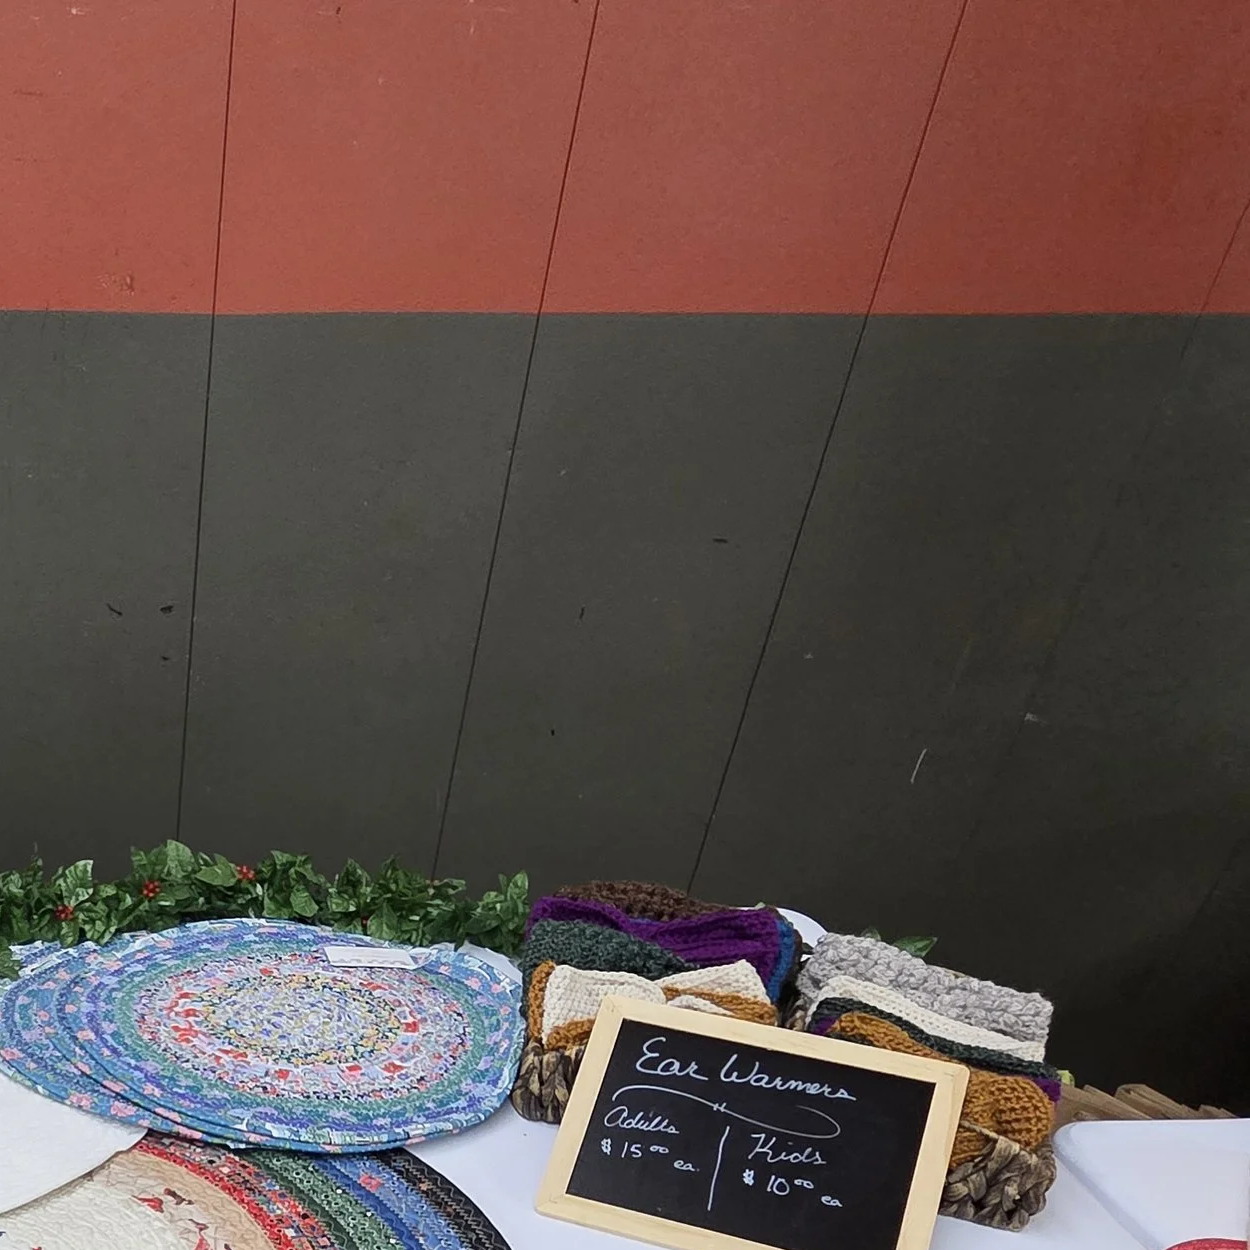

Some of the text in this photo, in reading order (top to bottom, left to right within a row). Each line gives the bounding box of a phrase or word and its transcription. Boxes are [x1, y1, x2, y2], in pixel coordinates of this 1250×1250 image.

[635, 1036, 858, 1102] Ear Warmers
[747, 1132, 828, 1166] Kids
